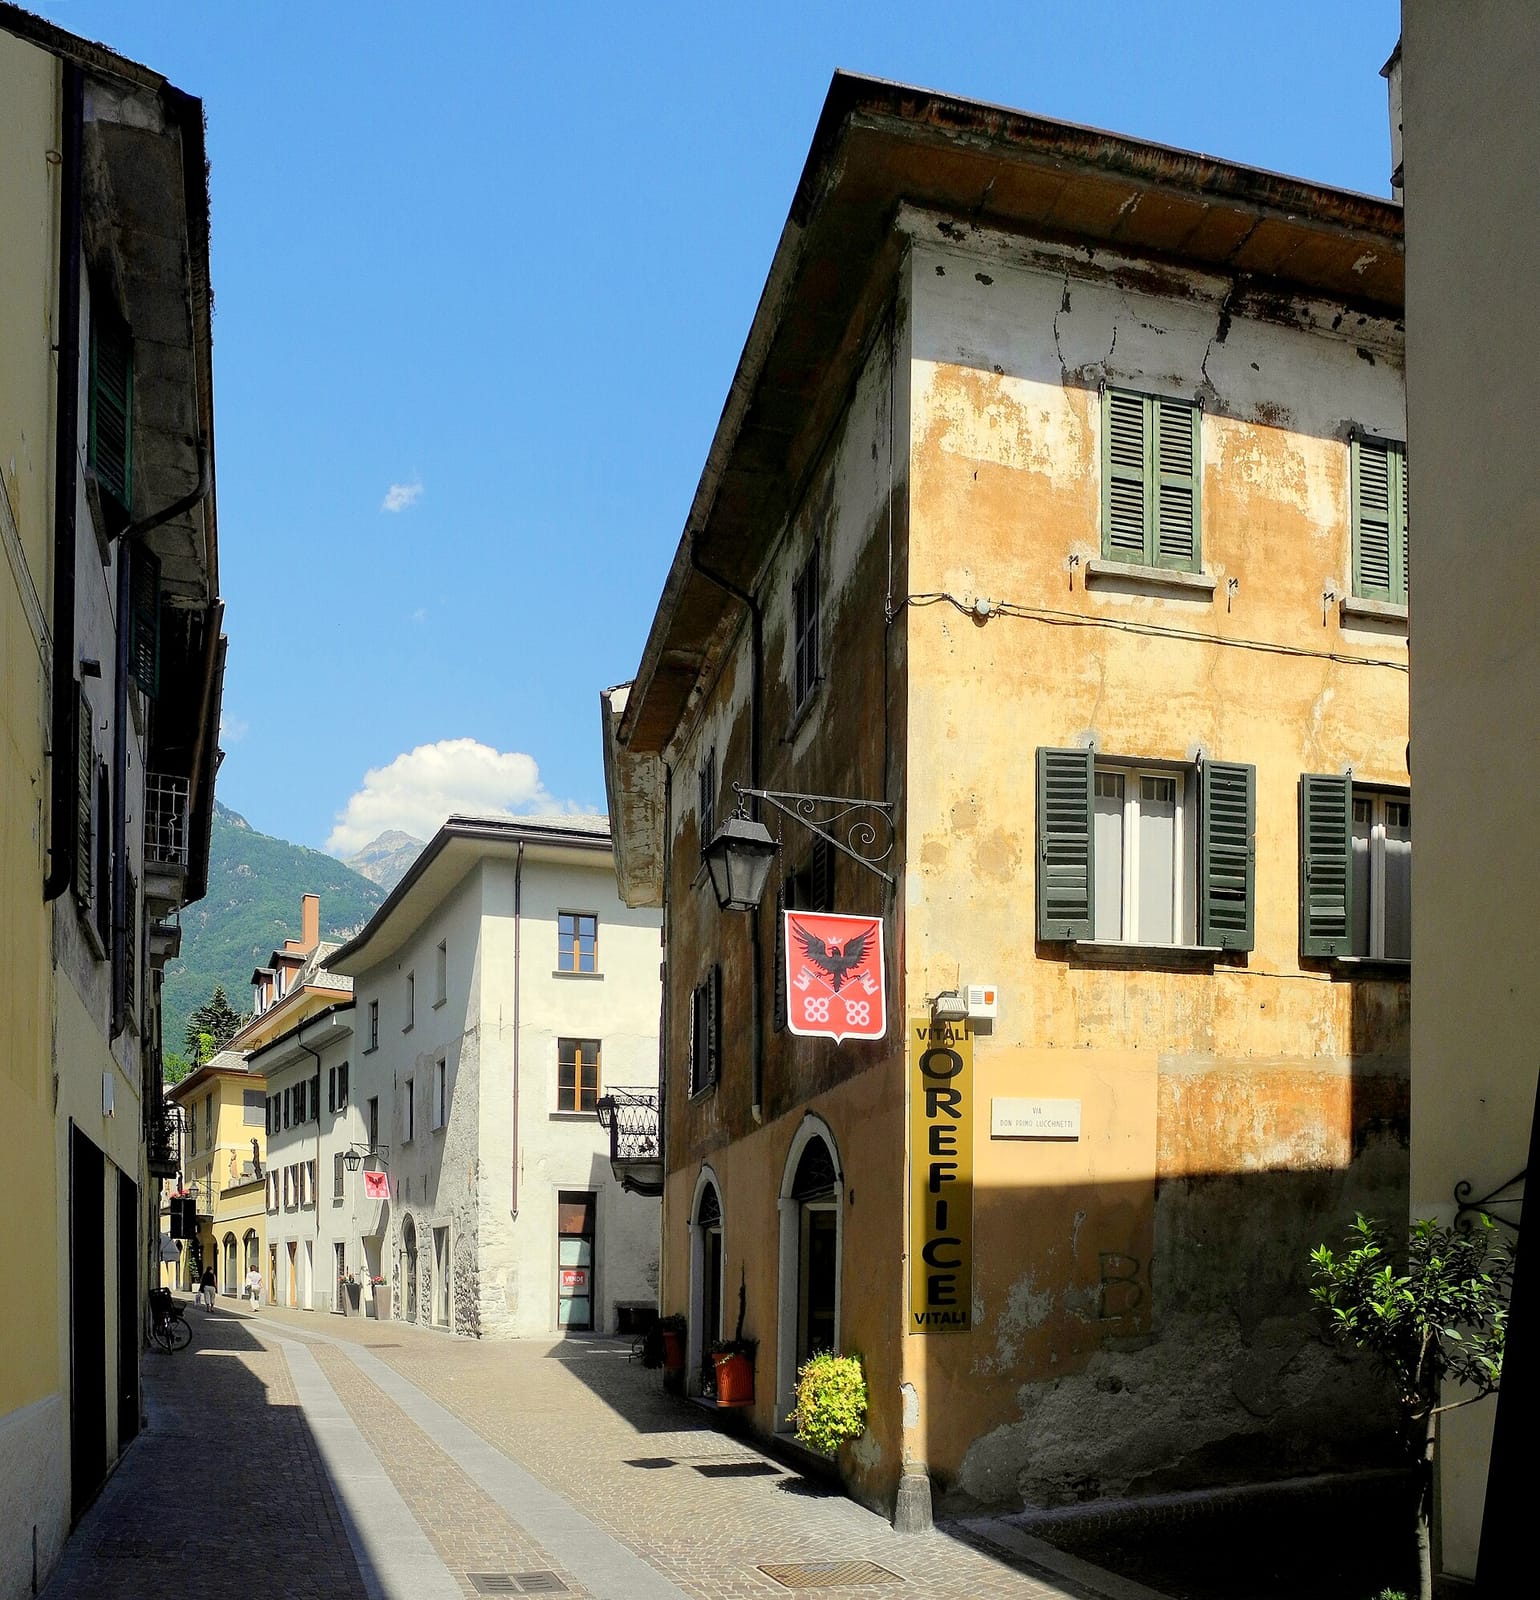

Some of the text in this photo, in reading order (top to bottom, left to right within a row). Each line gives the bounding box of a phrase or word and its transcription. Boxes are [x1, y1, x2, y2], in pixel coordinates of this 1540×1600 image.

[916, 1028, 969, 1041] VITALI
[1032, 1107, 1042, 1115] VIA
[1000, 1119, 1012, 1127] DON
[919, 1048, 963, 1306] OREFICE
[915, 1312, 966, 1325] VITALI
